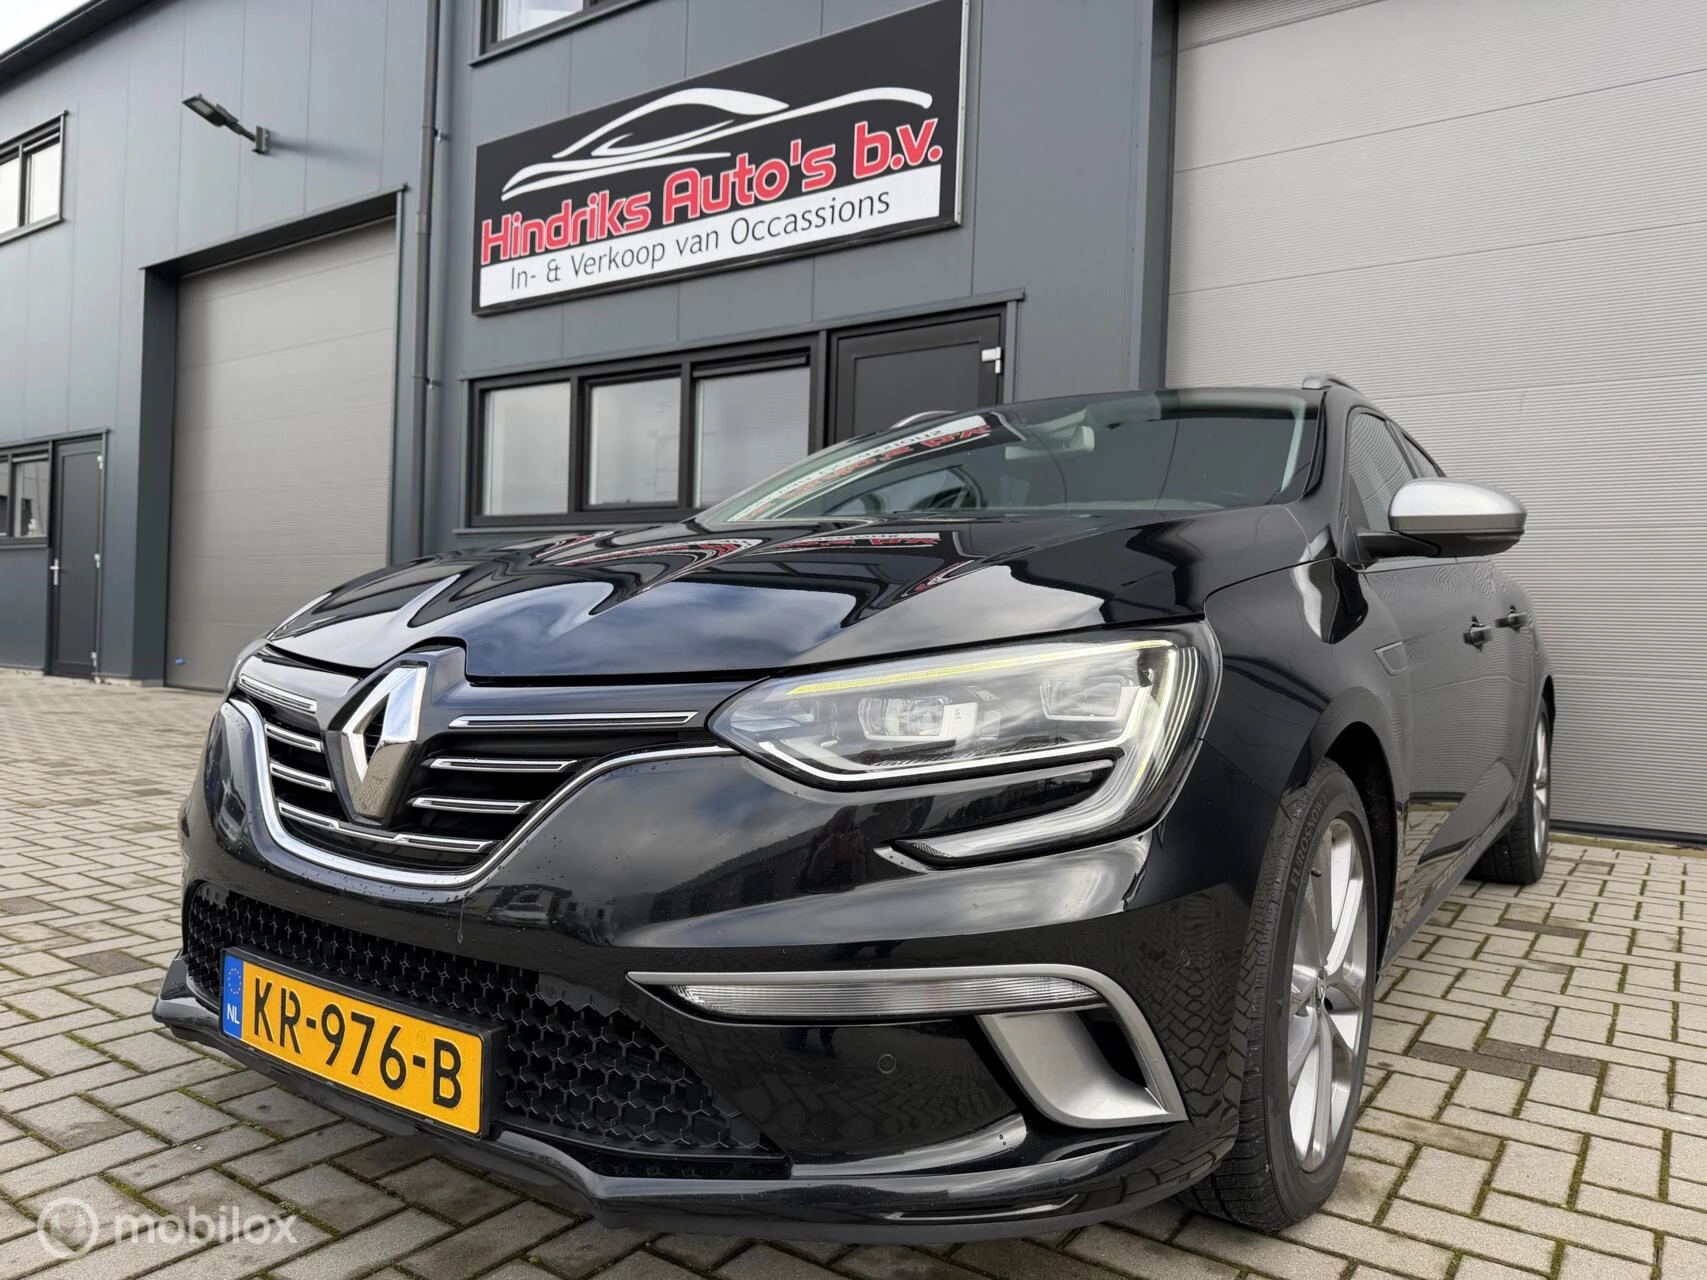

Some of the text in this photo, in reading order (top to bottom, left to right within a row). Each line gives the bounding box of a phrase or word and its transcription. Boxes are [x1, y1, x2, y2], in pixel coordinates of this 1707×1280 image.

[481, 118, 943, 265] Hindriks Auto's b.v.
[510, 189, 891, 290] In- & Verkoop van Occassions
[226, 1002, 240, 1025] NL
[254, 977, 462, 1109] KR-976-B
